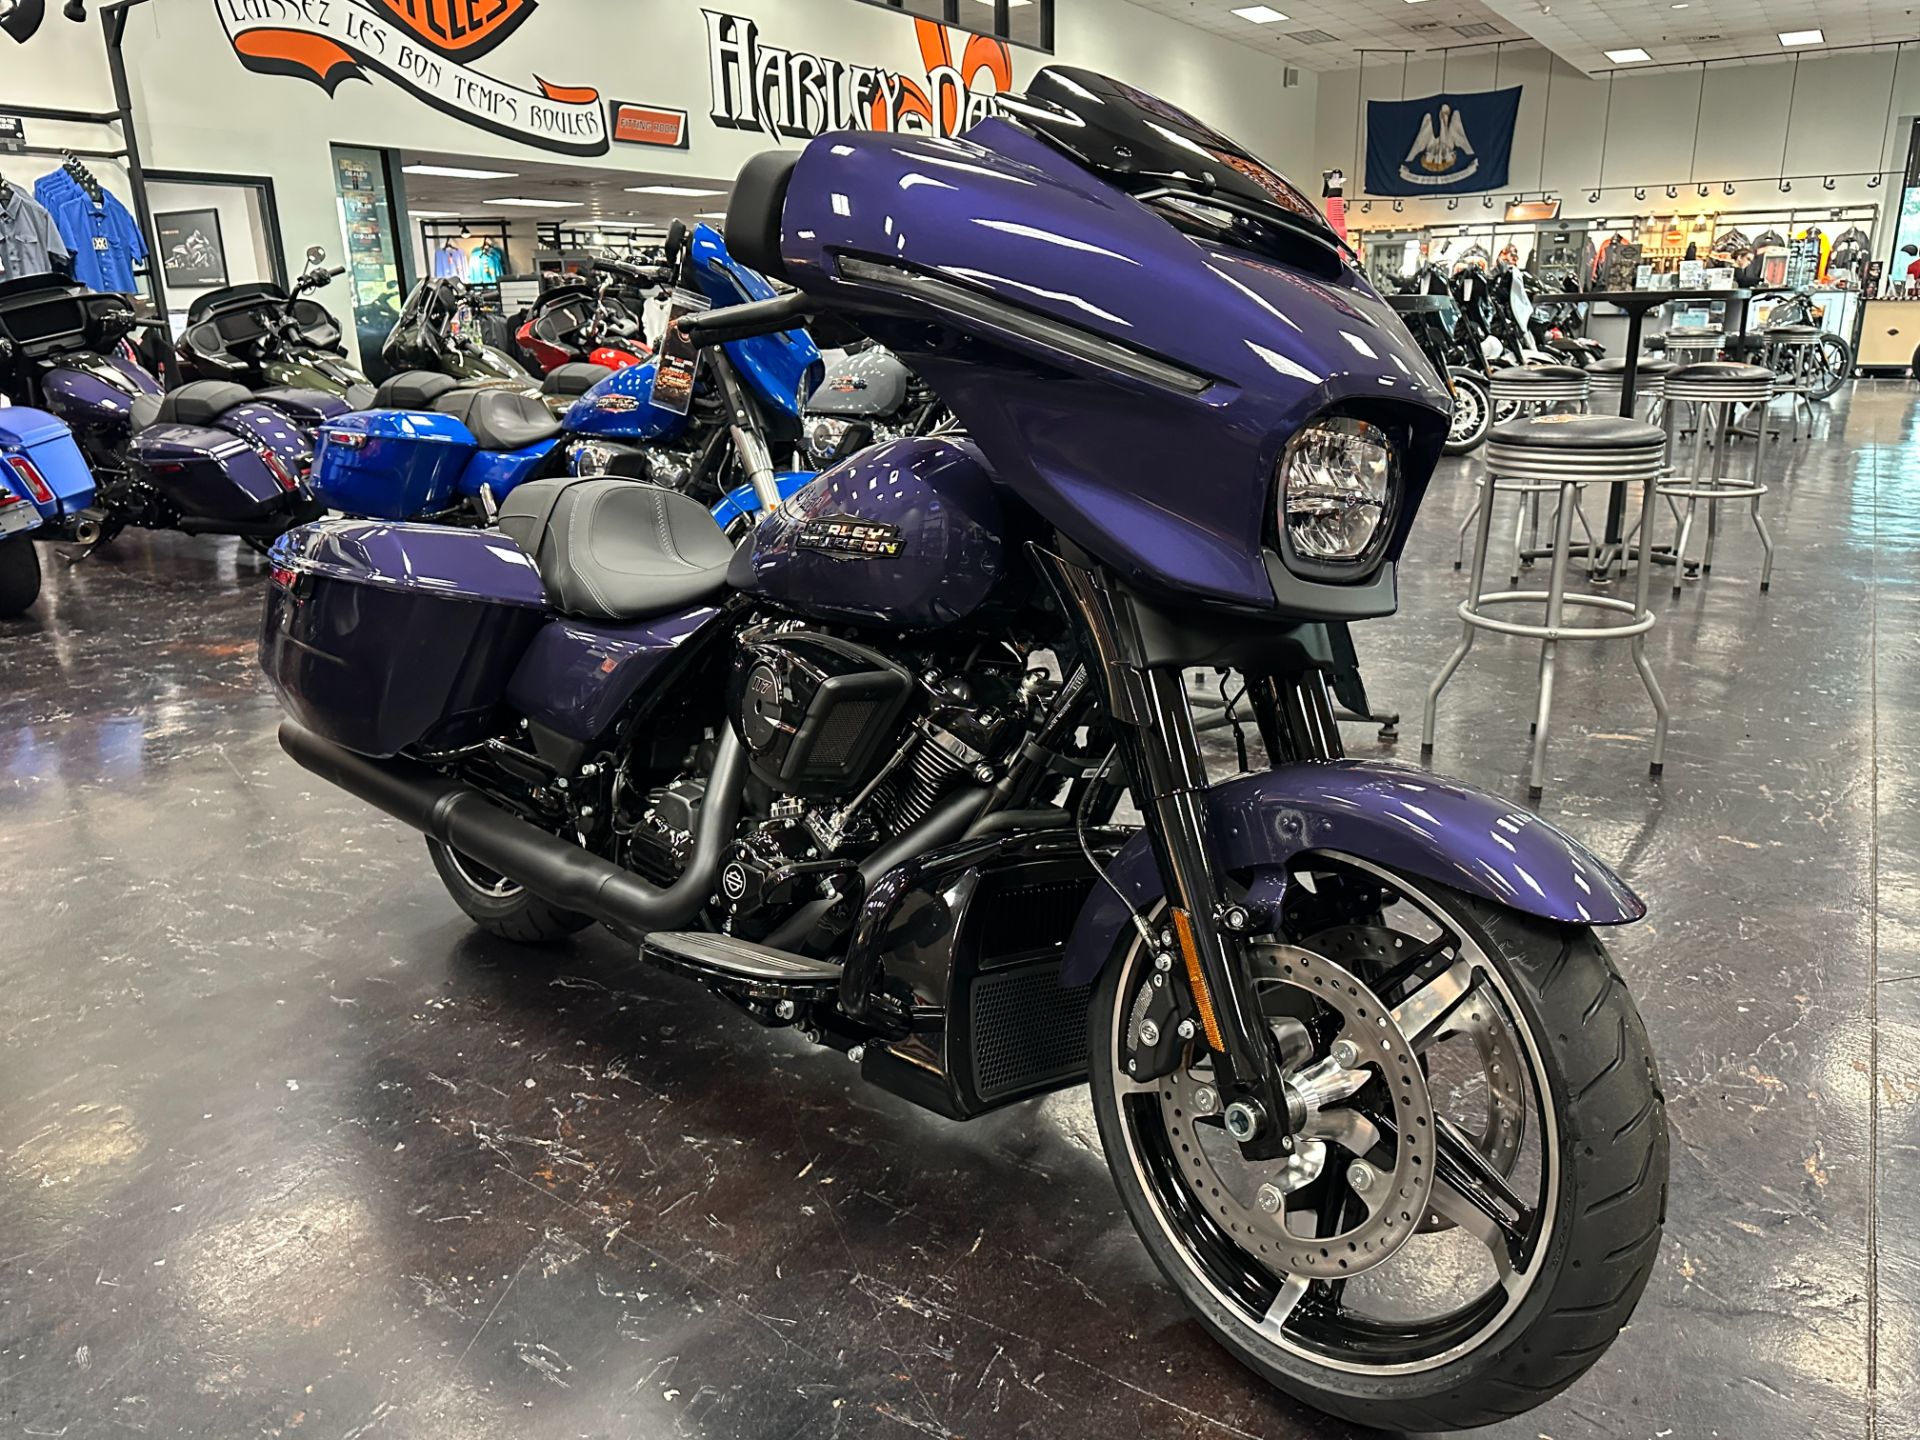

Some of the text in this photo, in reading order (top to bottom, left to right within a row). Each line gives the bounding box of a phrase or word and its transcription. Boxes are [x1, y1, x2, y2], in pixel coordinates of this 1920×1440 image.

[346, 12, 387, 55] LES
[398, 45, 442, 88] BON
[454, 75, 517, 121] TEMPS
[530, 105, 599, 137] ROULER
[700, 8, 1004, 145] HARLEY-DA
[621, 118, 677, 134] FITTING ROOM
[752, 676, 773, 694] 117
